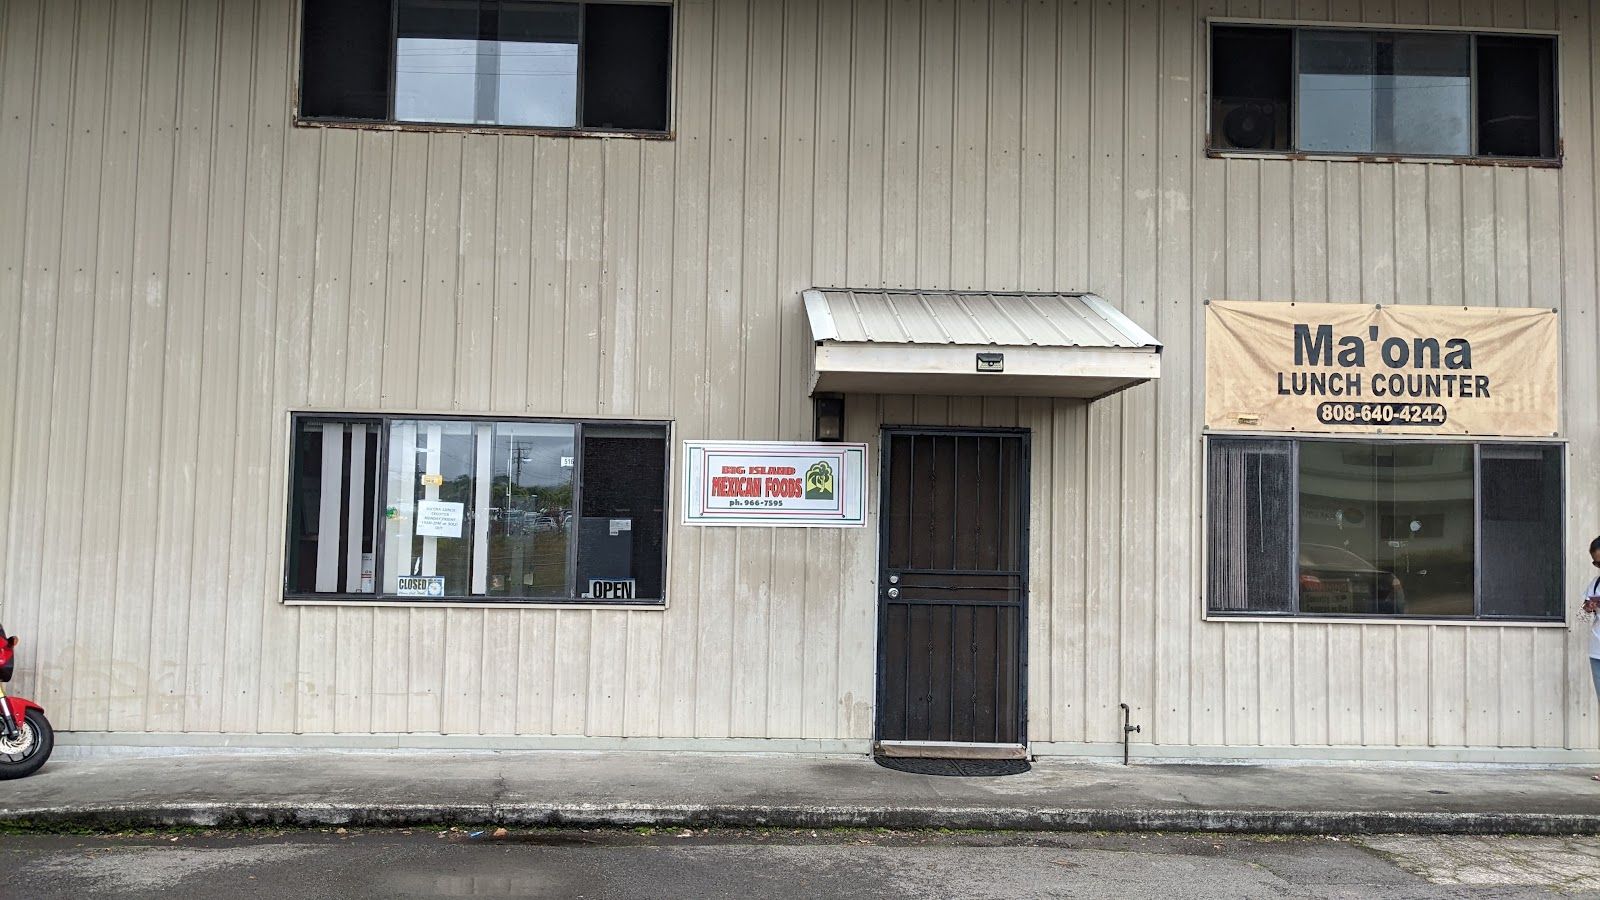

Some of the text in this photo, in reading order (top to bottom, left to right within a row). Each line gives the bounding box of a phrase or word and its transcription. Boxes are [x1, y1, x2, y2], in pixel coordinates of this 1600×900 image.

[1293, 323, 1472, 370] Ma'ona
[1277, 372, 1361, 397] LUNCH
[1371, 373, 1491, 398] COUNTER
[1321, 404, 1445, 423] 808-640-4244
[722, 466, 796, 475] BIG ISLAND
[711, 476, 803, 498] MEXICAN FOODS
[729, 499, 783, 507] ph. 966-7595
[399, 578, 427, 590] CLOSED
[593, 581, 632, 599] OPEN
